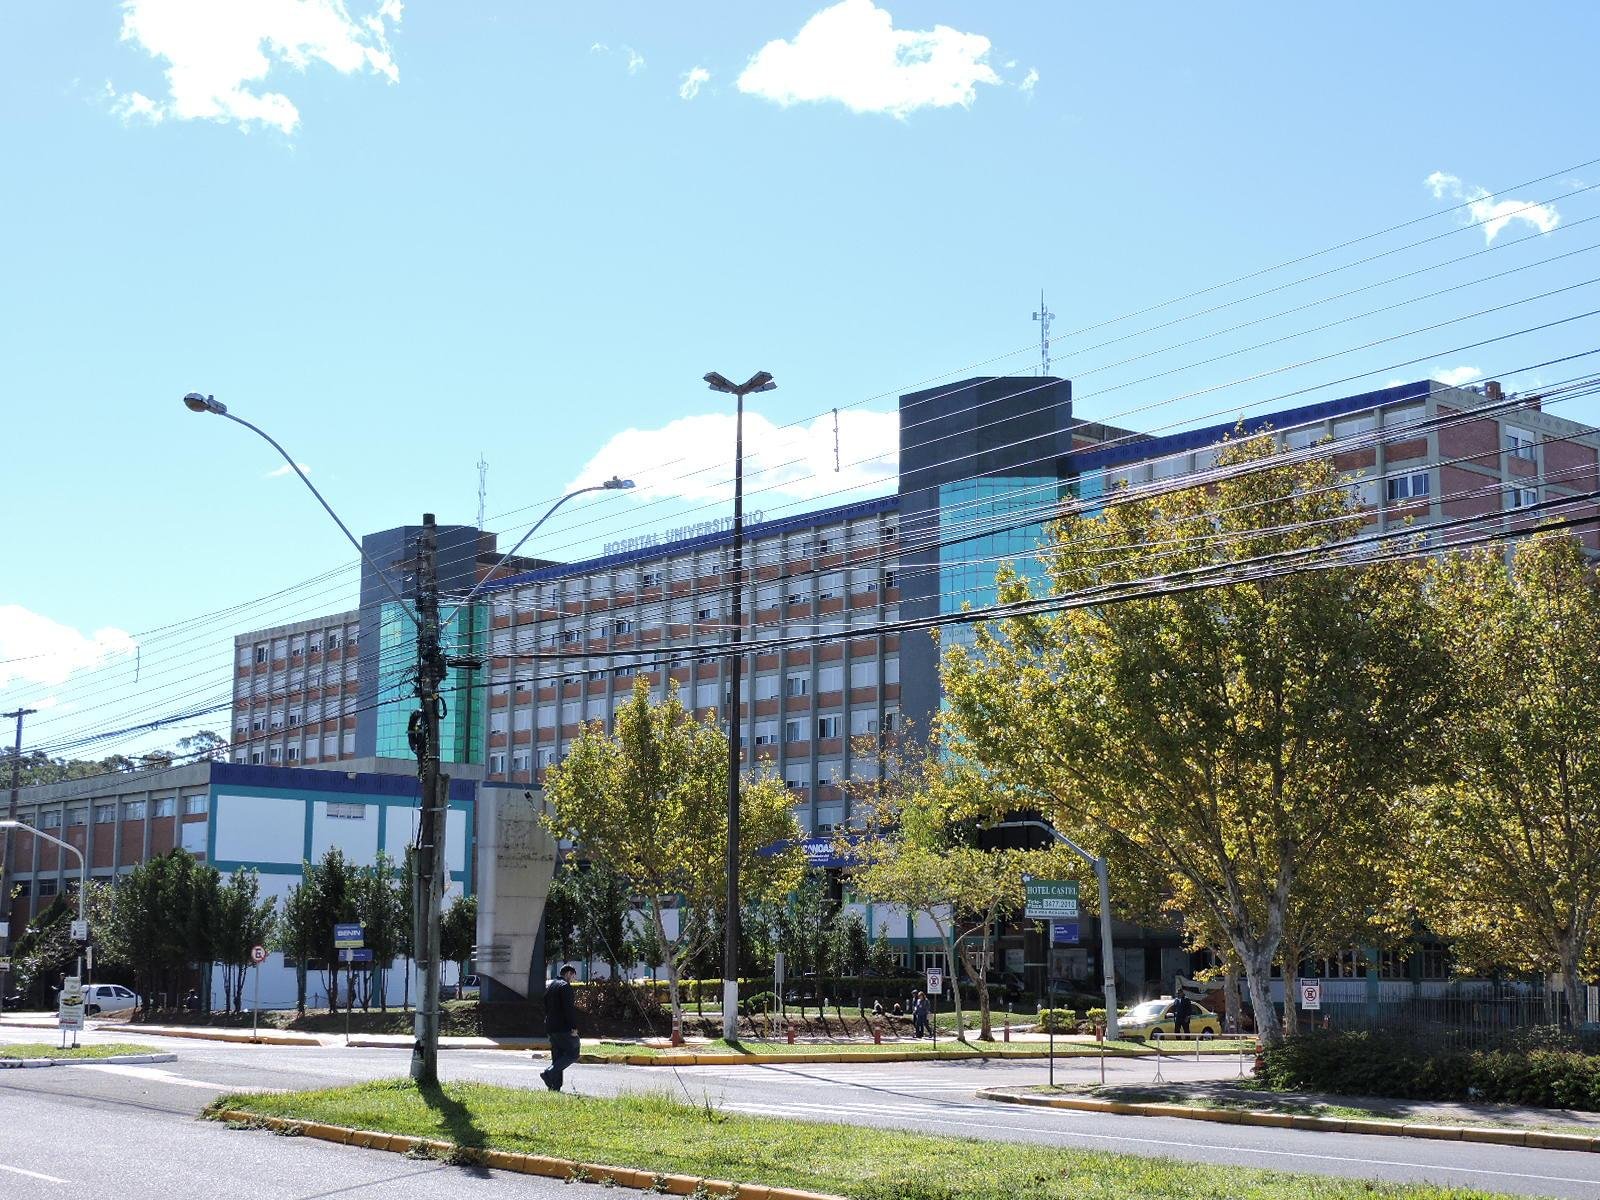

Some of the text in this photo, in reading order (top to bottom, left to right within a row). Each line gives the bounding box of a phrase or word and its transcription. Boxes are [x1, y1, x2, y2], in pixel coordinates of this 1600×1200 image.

[603, 533, 661, 557] HOSPITAL
[1027, 886, 1077, 895] HOTEL CASTEL
